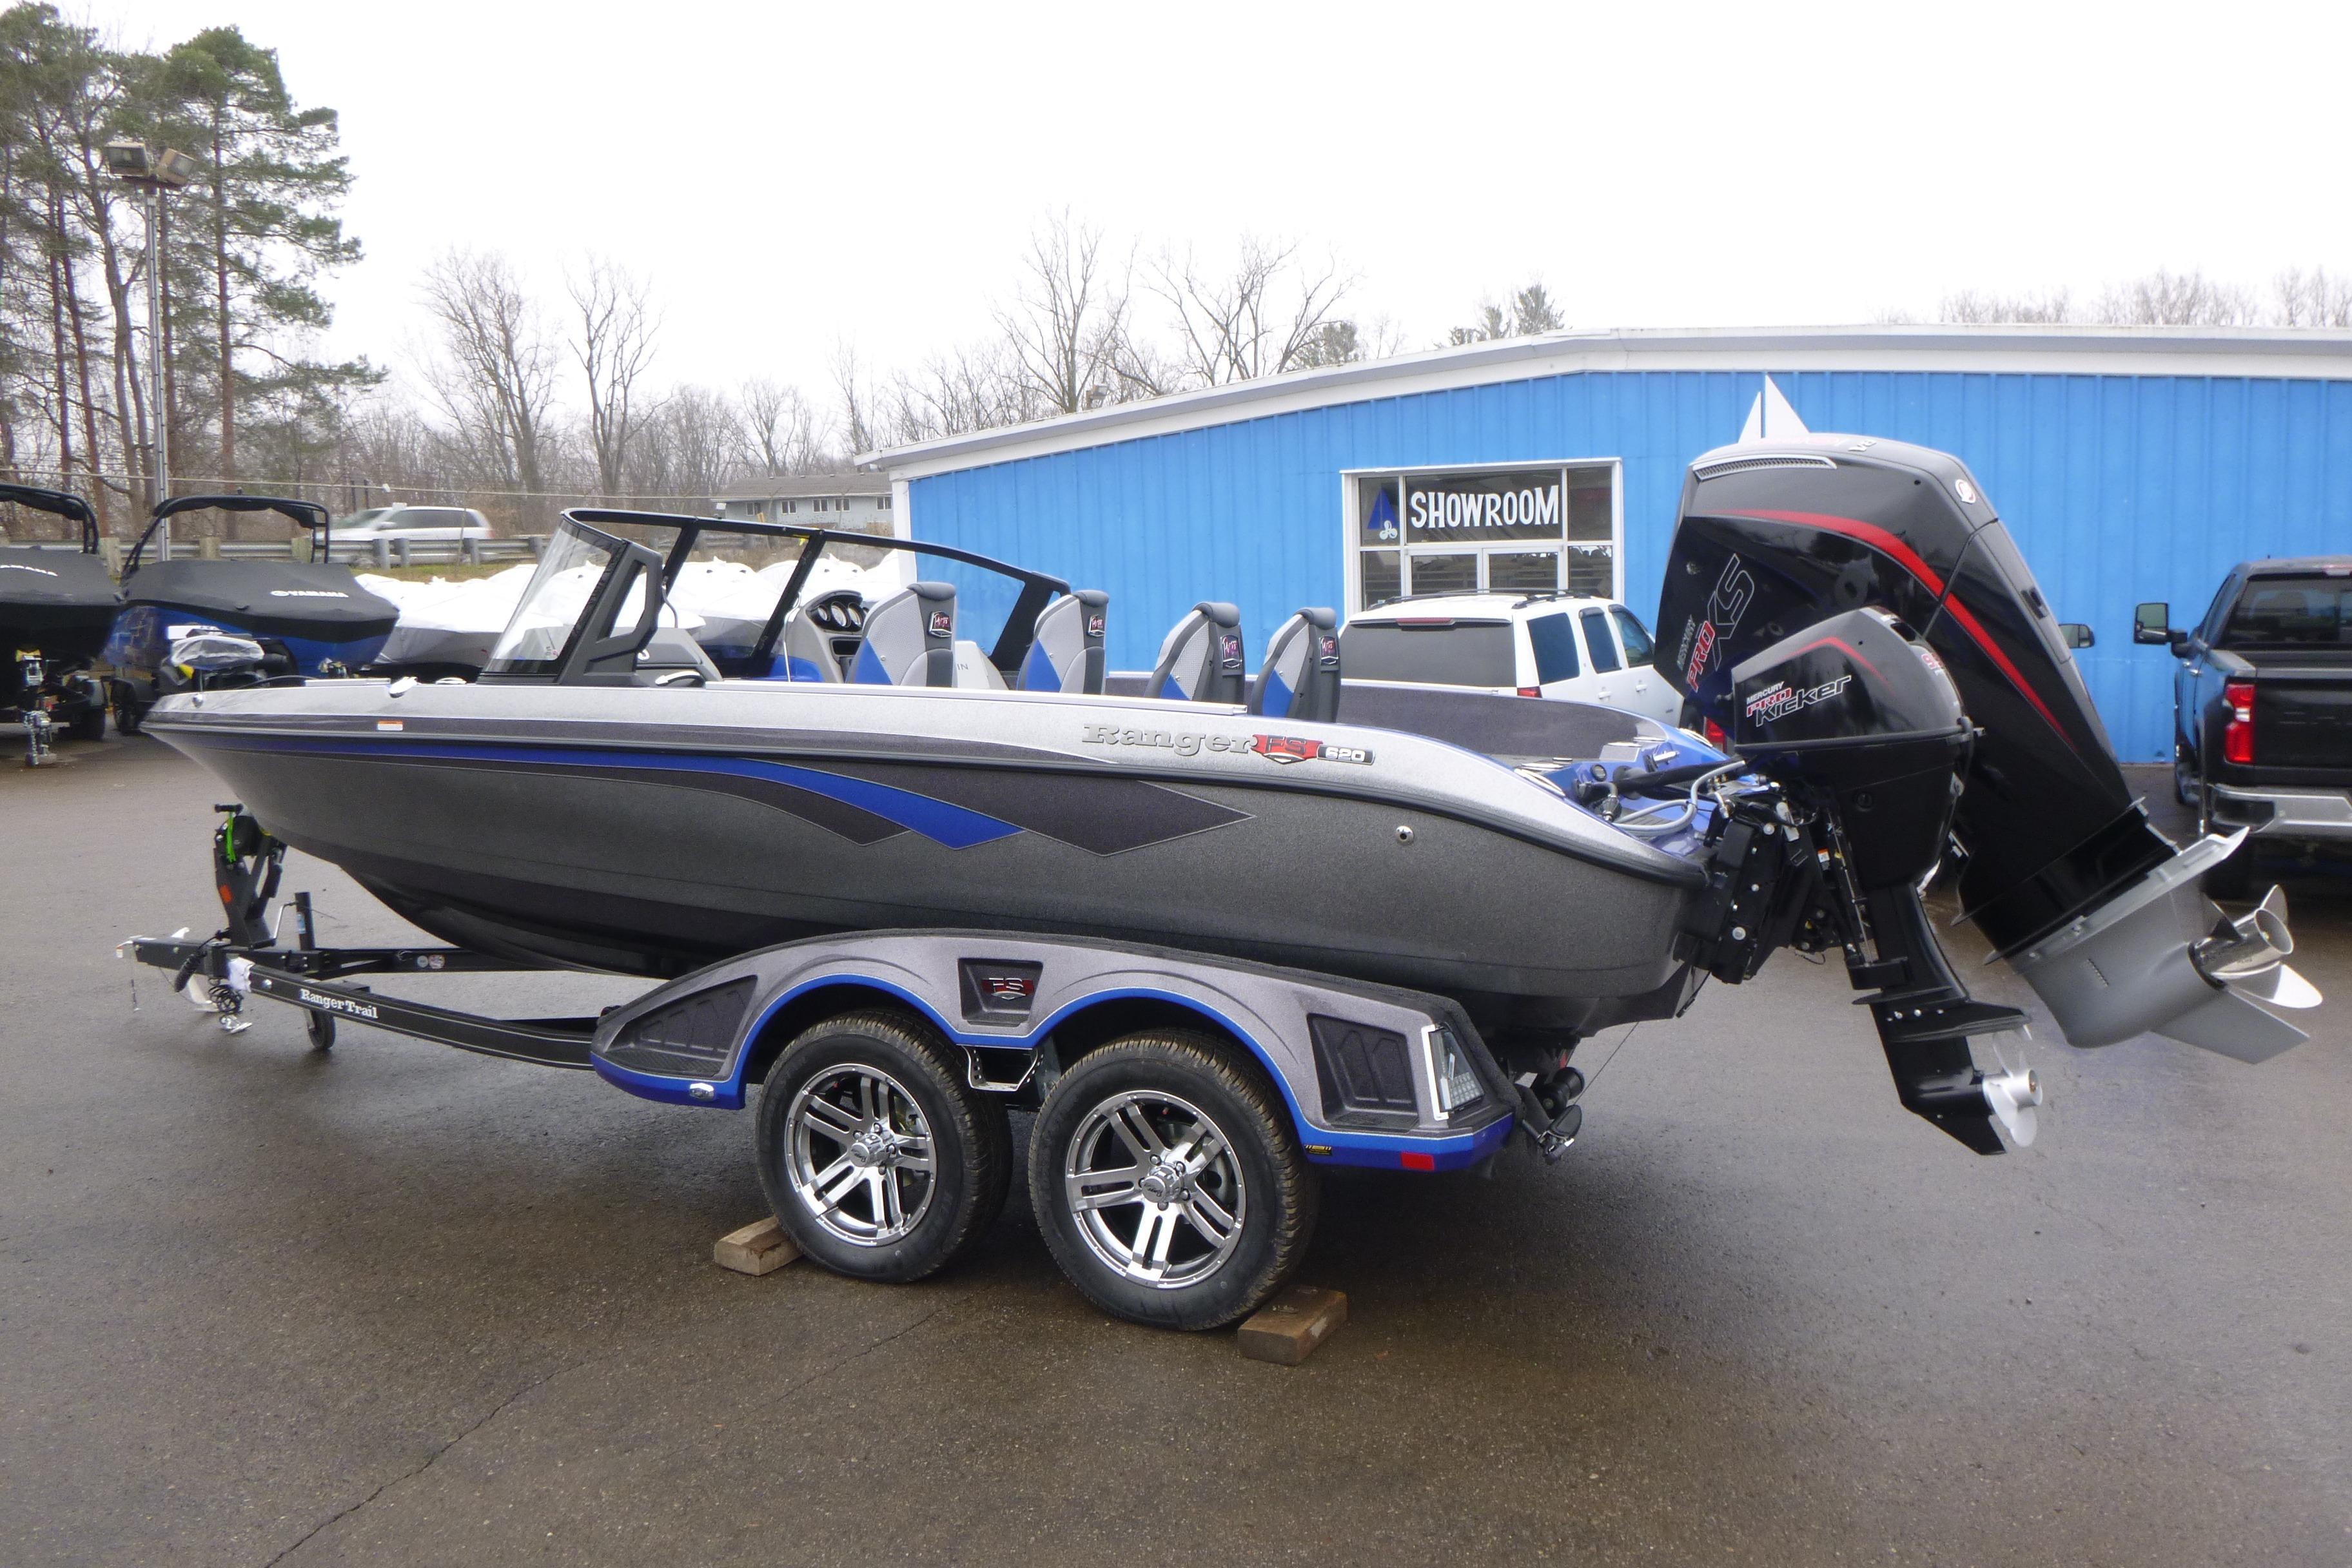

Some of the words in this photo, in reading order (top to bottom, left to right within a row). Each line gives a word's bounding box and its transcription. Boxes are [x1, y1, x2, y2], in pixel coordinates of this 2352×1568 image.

[1410, 485, 1559, 528] SHOWROOM
[1677, 614, 1696, 671] MERCURY
[1687, 621, 1716, 693] PRO
[1707, 553, 1754, 672] XS
[1747, 681, 1785, 705] MERCURY
[1747, 687, 1792, 718] PRO
[1082, 723, 1259, 756] Ranger
[1265, 734, 1308, 755] FS
[1325, 747, 1365, 762] 620
[988, 977, 1024, 993] FS
